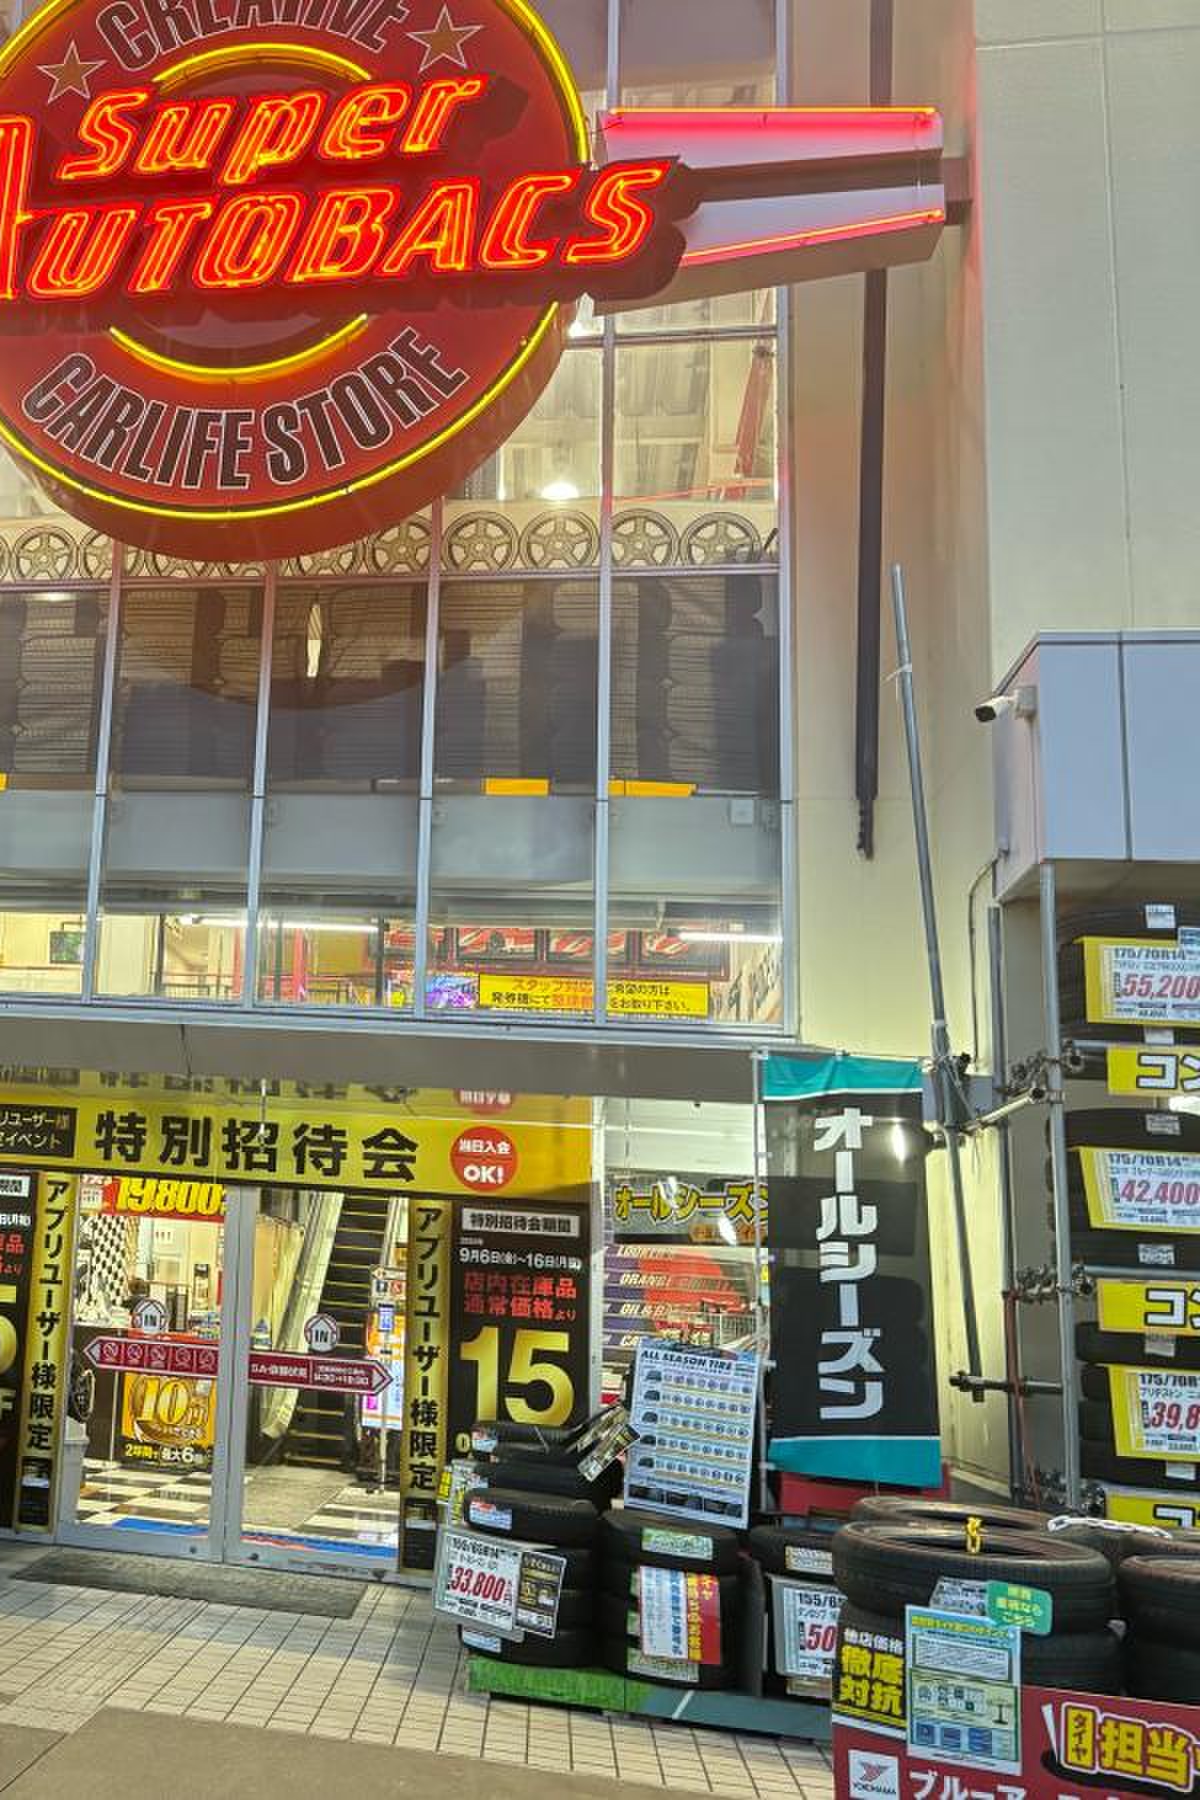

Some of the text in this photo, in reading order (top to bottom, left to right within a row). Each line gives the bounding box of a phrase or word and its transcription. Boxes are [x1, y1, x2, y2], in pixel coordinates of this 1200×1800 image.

[21, 325, 469, 490] CARLIFE STORE
[96, 1110, 419, 1183] 特別招待会
[463, 1164, 505, 1185] OK!
[813, 1107, 884, 1420] オールシーズン
[459, 1325, 575, 1428] 15
